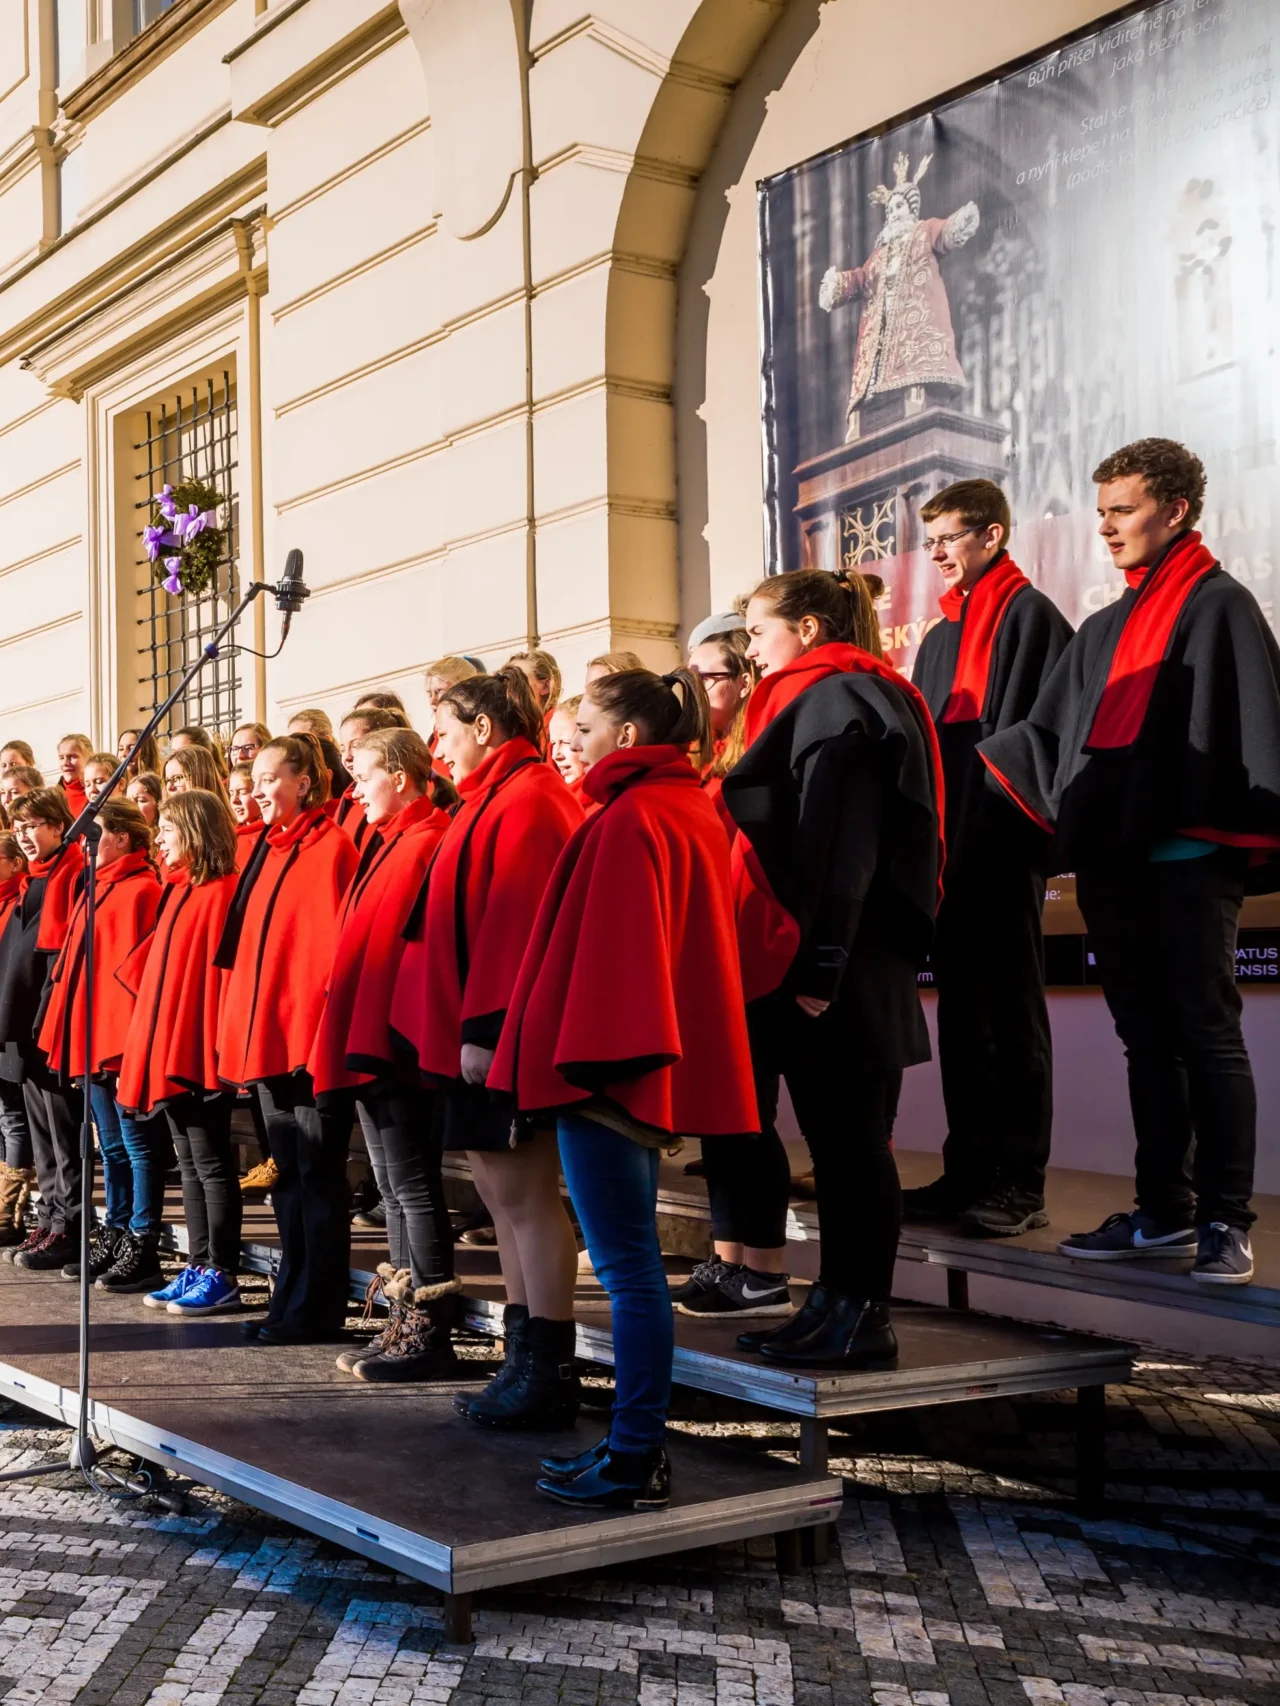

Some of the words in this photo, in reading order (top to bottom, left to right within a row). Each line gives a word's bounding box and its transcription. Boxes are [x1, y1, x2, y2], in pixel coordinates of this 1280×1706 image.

[1027, 64, 1055, 88] Bůh
[1058, 42, 1096, 78] přišel
[1099, 13, 1162, 54] viditelně
[1166, 4, 1187, 24] na
[1110, 49, 1144, 78] jako
[1080, 109, 1108, 134] Stal
[1111, 105, 1126, 121] se
[1016, 171, 1026, 185] a
[1028, 153, 1061, 181] nyní
[1061, 141, 1100, 166] klepe
[1110, 127, 1130, 147] na
[1235, 947, 1279, 960] ATUS
